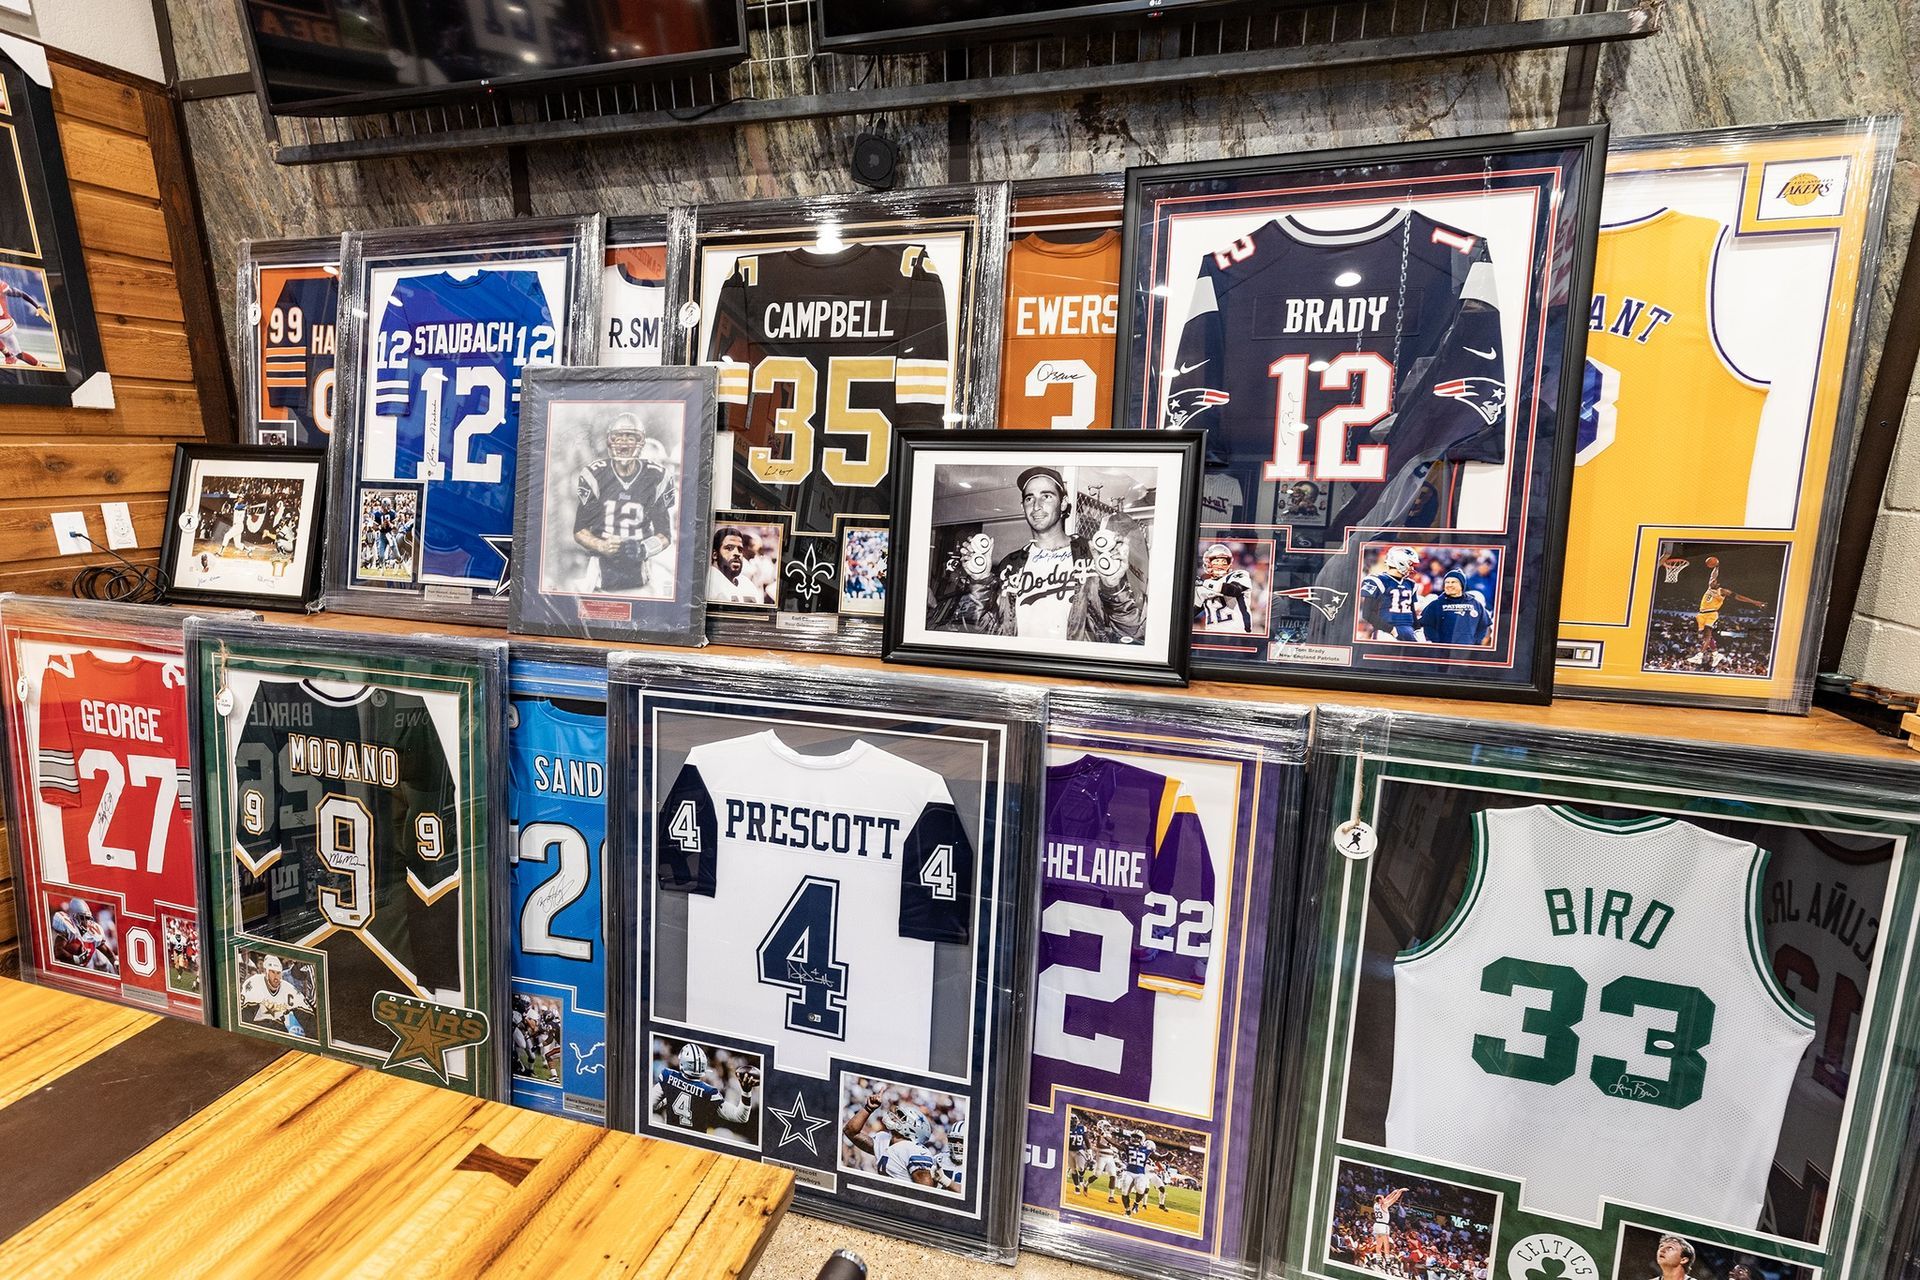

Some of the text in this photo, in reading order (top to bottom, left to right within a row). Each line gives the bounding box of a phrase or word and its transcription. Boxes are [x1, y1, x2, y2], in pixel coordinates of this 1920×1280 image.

[1776, 181, 1832, 199] LAKERS
[269, 306, 303, 344] 99
[764, 299, 894, 339] CAMPBELL
[1016, 294, 1119, 336] EWERS
[1283, 296, 1389, 334] BRADY
[377, 330, 412, 369] 12
[414, 322, 514, 356] STAUBACH
[512, 325, 556, 367] 12
[416, 366, 506, 483] 12
[747, 356, 897, 487] 35
[1263, 351, 1394, 482] 12
[601, 500, 644, 539] 12
[1389, 589, 1413, 613] 12
[80, 699, 163, 743] GEORGE
[288, 733, 399, 788] MODANO
[534, 755, 604, 799] SAND
[78, 748, 178, 874] 27
[243, 789, 265, 836] 9
[668, 800, 702, 853] 4
[725, 798, 899, 860] PRESCOTT
[414, 812, 445, 861] 9
[315, 792, 376, 931] 9
[920, 844, 957, 902] 4
[519, 821, 607, 962] 2
[1139, 890, 1215, 958] 22
[1544, 887, 1675, 950] BIRD
[756, 874, 849, 1042] 4
[287, 993, 294, 1007] C
[388, 995, 473, 1018] DALLAS
[1033, 900, 1134, 1075] 2
[376, 1000, 484, 1040] STARS
[1472, 956, 1716, 1110] 33
[666, 1075, 705, 1098] PRESCOTT
[671, 1092, 694, 1128] 4
[791, 1165, 818, 1177] Prescott
[795, 1174, 821, 1186] Cowboys
[1128, 1149, 1147, 1168] 22
[1516, 1239, 1593, 1275] CELTICS
